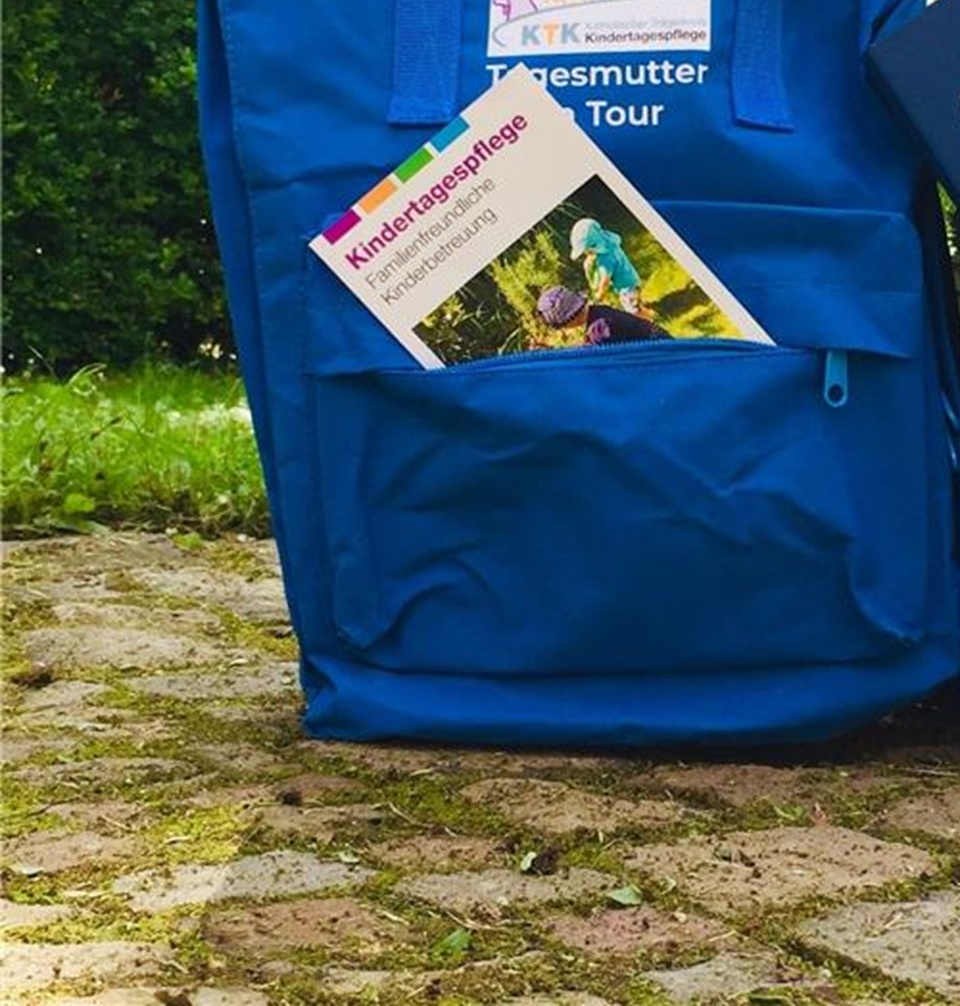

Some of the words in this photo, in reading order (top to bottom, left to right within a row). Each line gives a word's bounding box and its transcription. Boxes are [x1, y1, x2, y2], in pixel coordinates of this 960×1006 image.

[521, 22, 581, 46] KTK
[585, 29, 706, 44] Kindertagespflege
[585, 99, 664, 127] Tour
[344, 114, 529, 270] Kindertagespflege
[365, 177, 497, 290] Familienfreundliche
[380, 207, 499, 307] Kinderbetreuung
